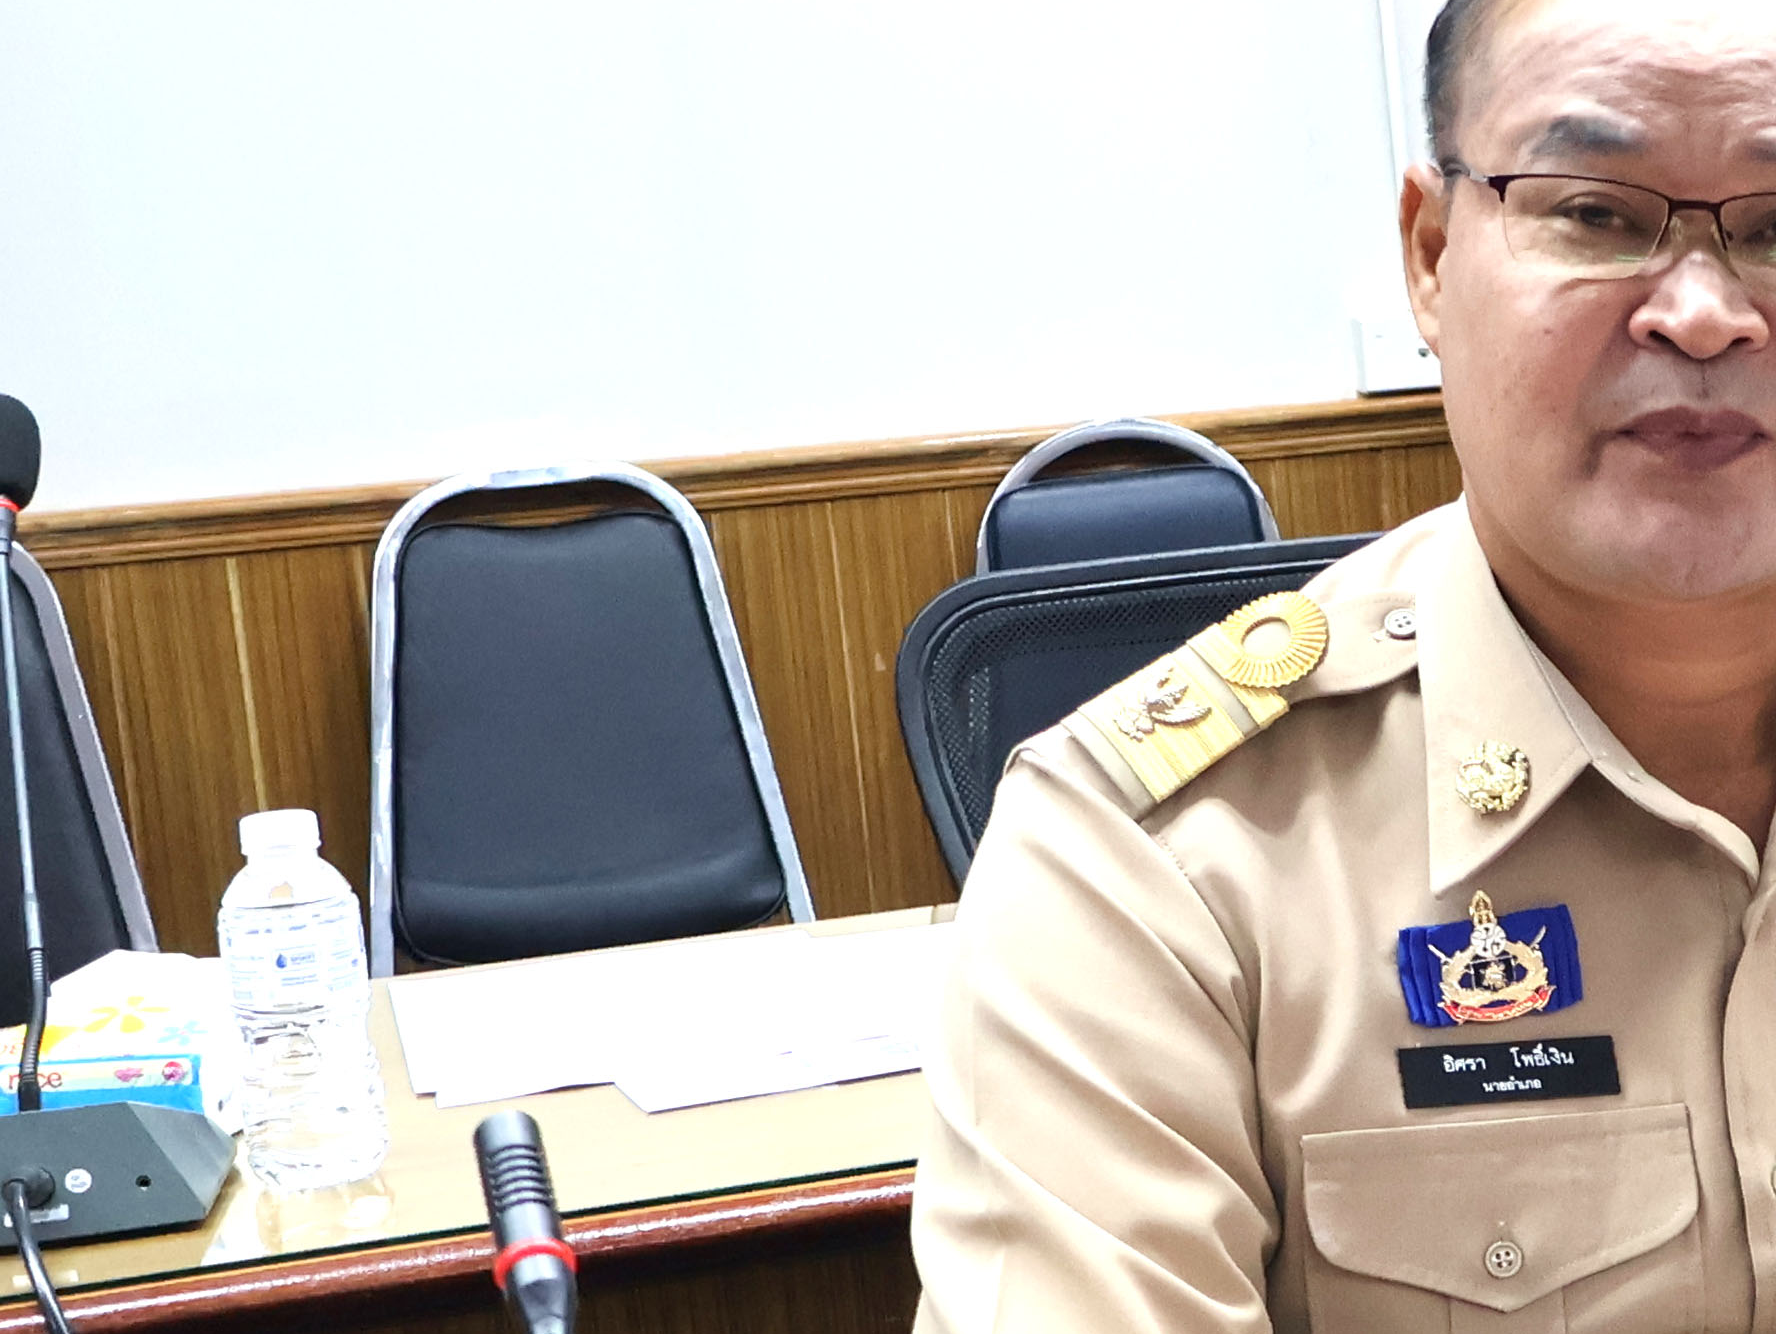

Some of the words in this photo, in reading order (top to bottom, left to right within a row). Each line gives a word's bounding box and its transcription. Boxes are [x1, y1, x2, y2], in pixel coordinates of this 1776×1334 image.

[1442, 1054, 1486, 1073] อิศรา
[1510, 1043, 1574, 1068] โพธิ์เงิน
[9, 1071, 63, 1089] nce
[1482, 1076, 1541, 1092] นายอำเภอ
